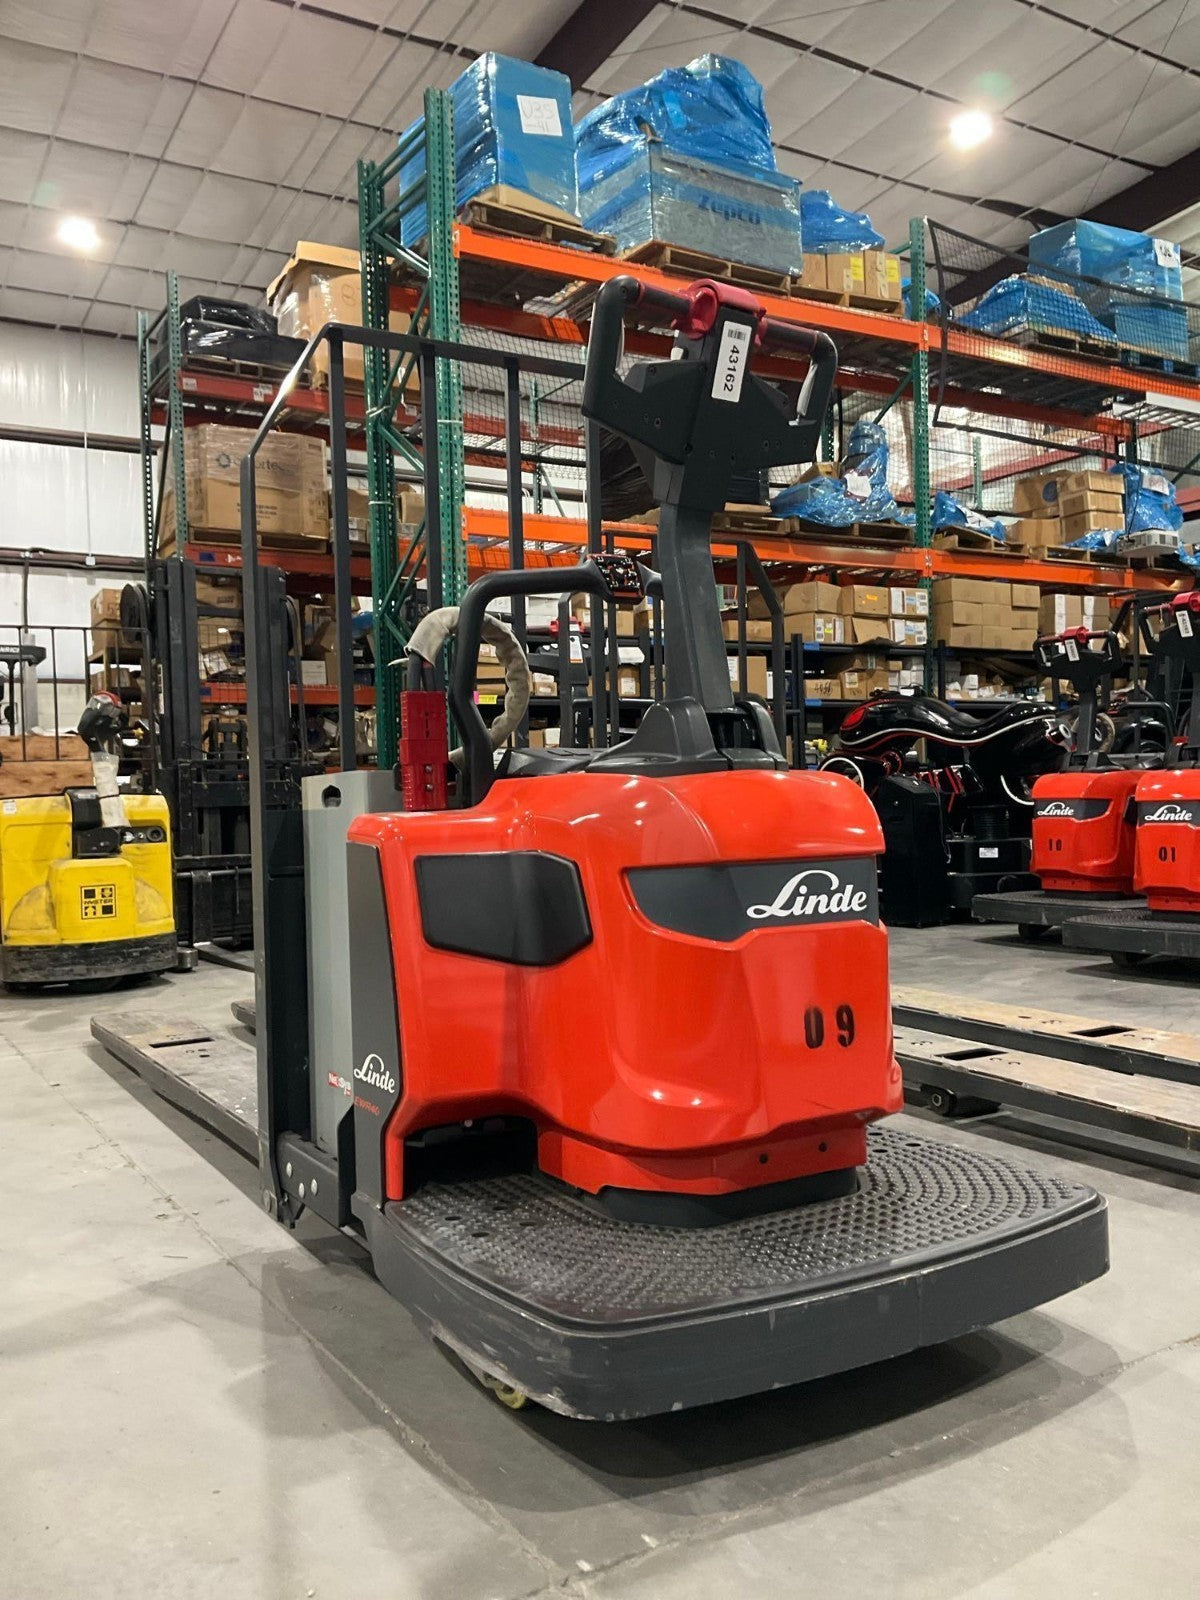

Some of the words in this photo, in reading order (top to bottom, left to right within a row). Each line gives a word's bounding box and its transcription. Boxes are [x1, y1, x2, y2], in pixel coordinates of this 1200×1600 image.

[723, 345, 740, 392] 43162
[1037, 801, 1075, 816] Linde
[1144, 804, 1193, 822] Linde
[1158, 846, 1177, 863] 01
[746, 869, 868, 919] Linde
[353, 1053, 396, 1094] Linde
